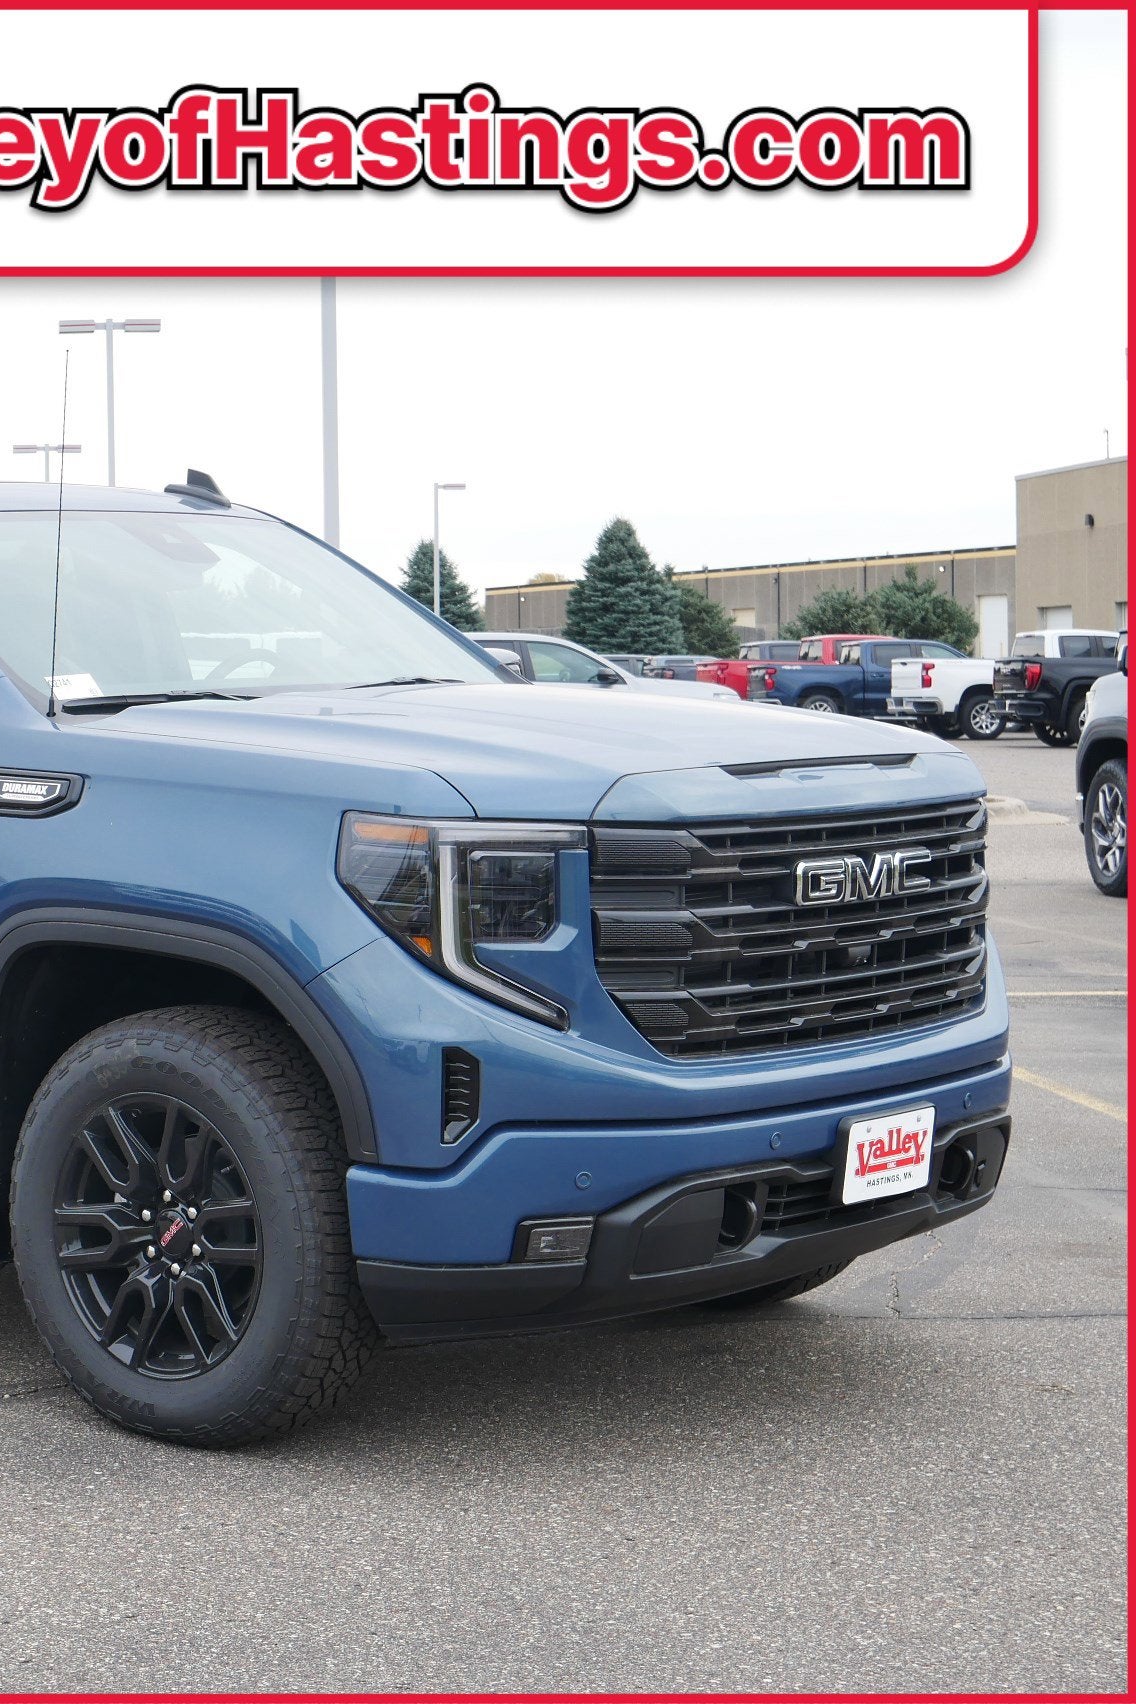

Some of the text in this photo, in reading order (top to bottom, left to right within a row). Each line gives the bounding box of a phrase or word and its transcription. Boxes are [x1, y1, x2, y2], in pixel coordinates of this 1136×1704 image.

[1, 782, 49, 795] DURAMAX
[796, 849, 931, 906] GMC
[855, 1128, 927, 1177] Valley
[866, 1174, 902, 1188] HASTINGS,
[160, 1217, 184, 1247] GMC
